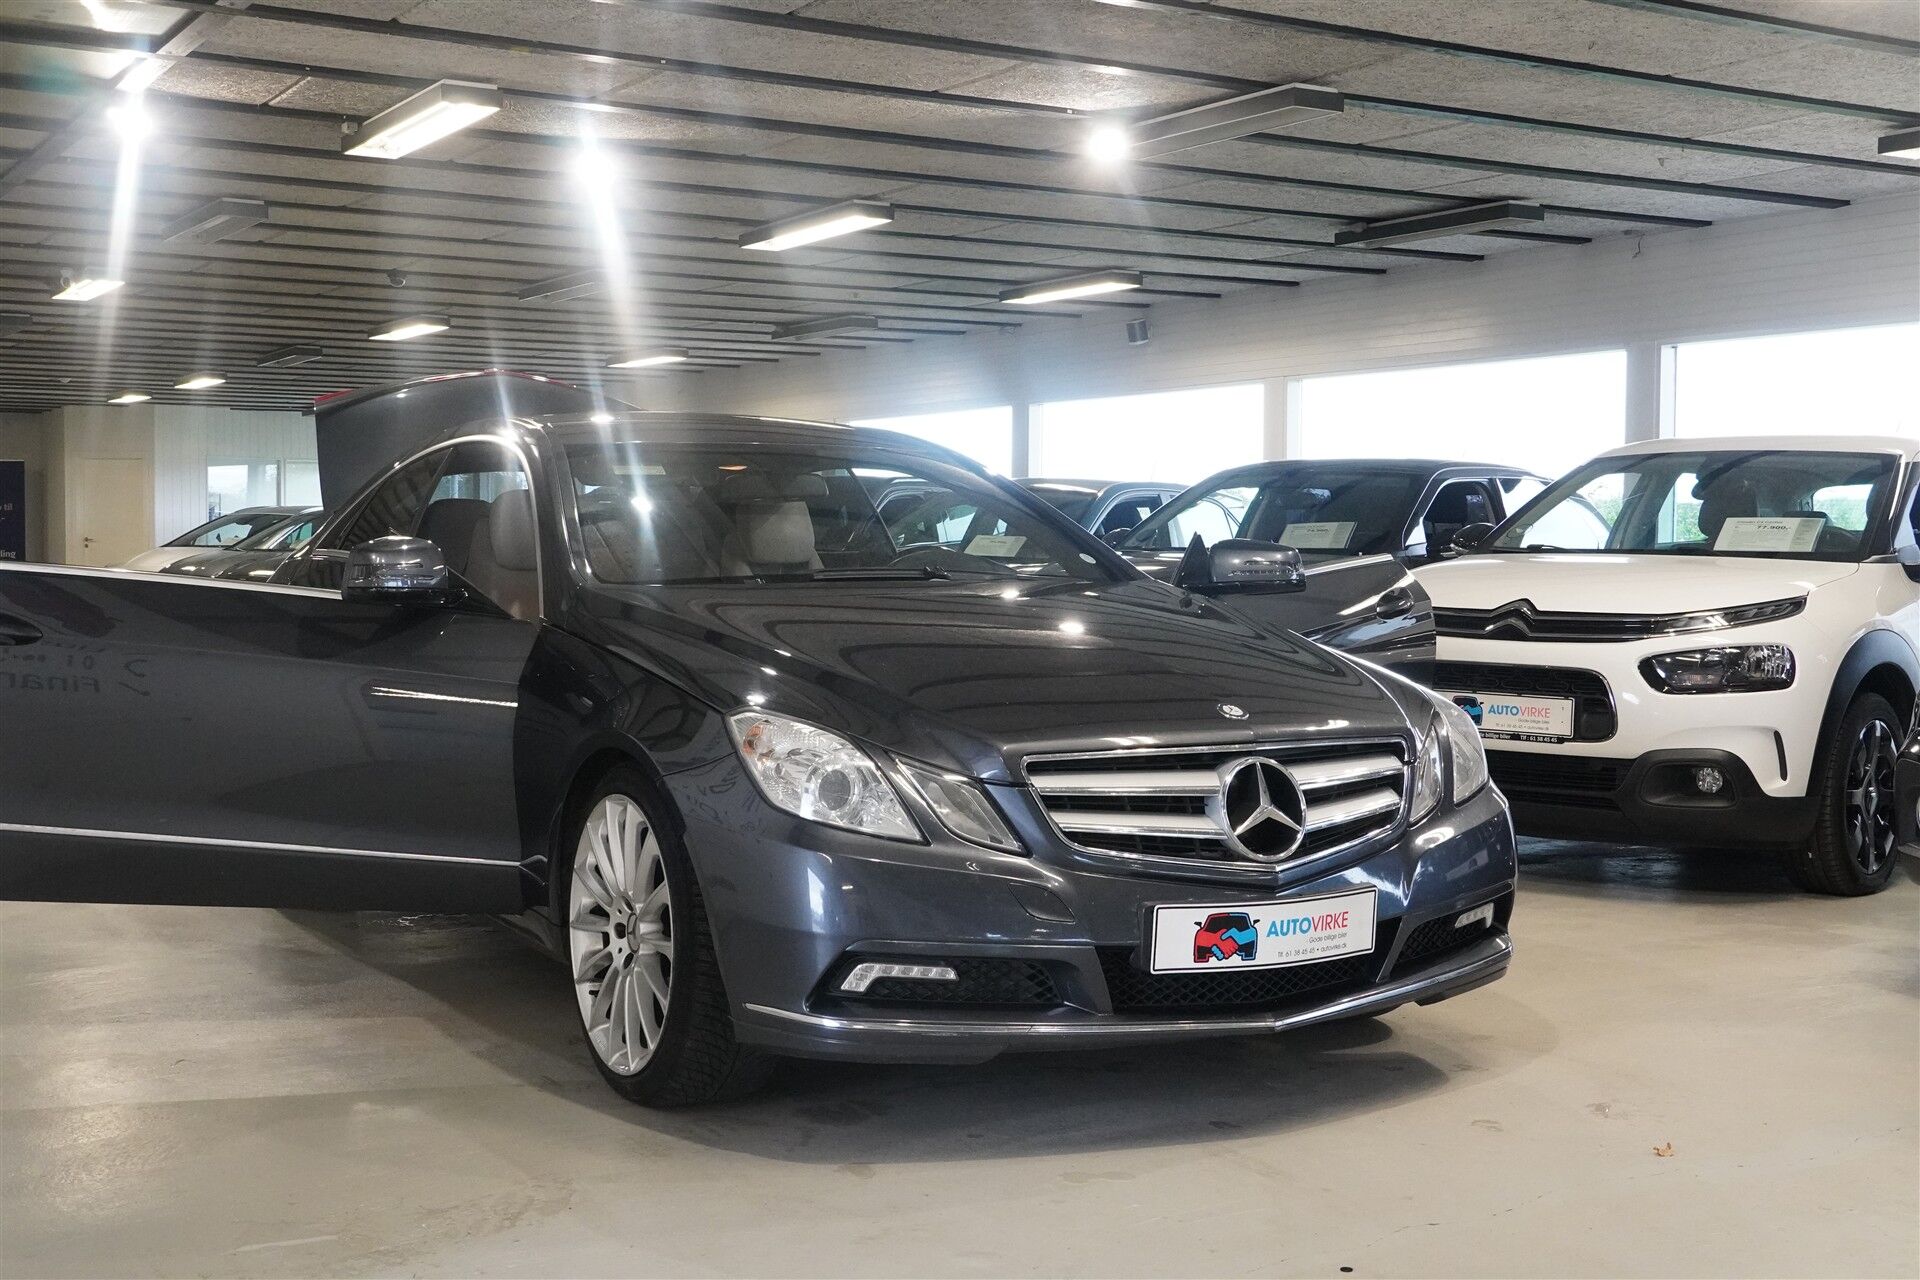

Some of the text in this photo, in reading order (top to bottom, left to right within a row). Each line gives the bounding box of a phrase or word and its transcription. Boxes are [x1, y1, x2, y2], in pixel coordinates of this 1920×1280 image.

[1488, 704, 1551, 718] AUTOVIRKE
[1266, 911, 1349, 938] AUTOVIRKE
[1285, 950, 1292, 958] 61
[1294, 949, 1301, 957] 38
